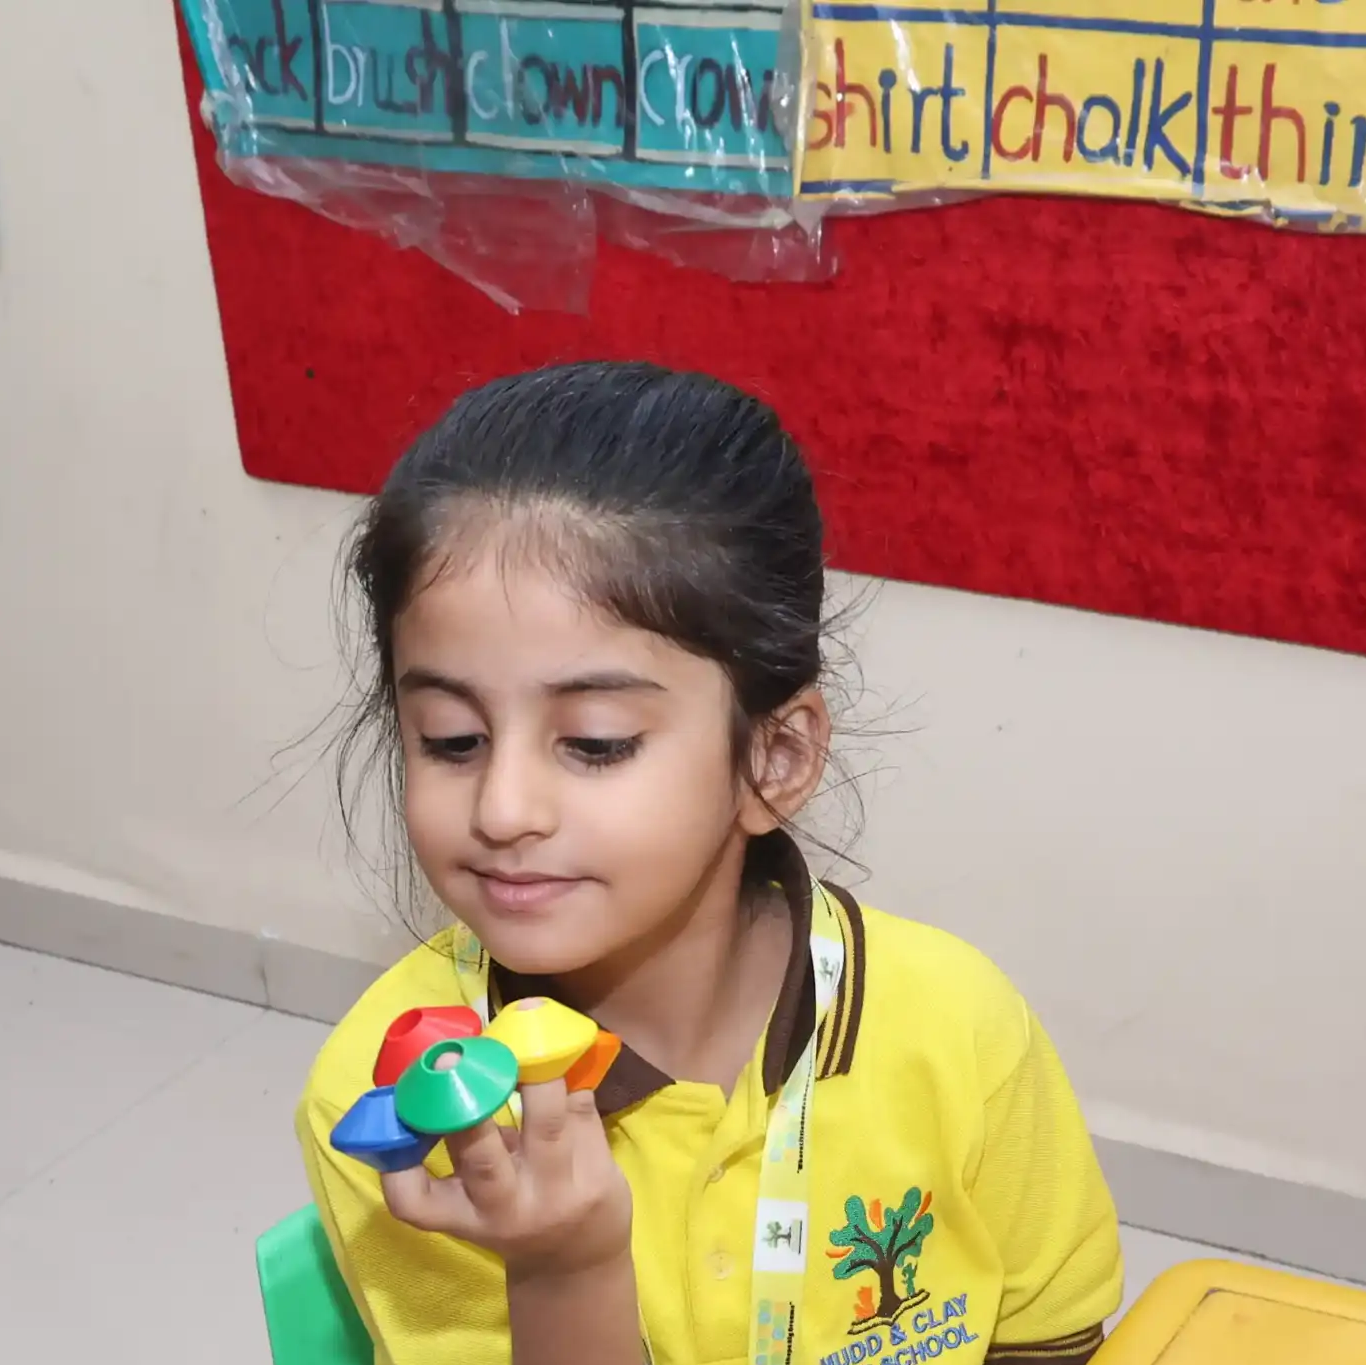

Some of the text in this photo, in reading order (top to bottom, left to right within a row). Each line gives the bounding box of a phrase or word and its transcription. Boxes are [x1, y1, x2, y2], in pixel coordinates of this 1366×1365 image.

[465, 18, 625, 127] clown
[807, 38, 969, 162] shirt
[991, 53, 1193, 177] chalk
[889, 1322, 908, 1346] &
[911, 1292, 968, 1335] CLAY
